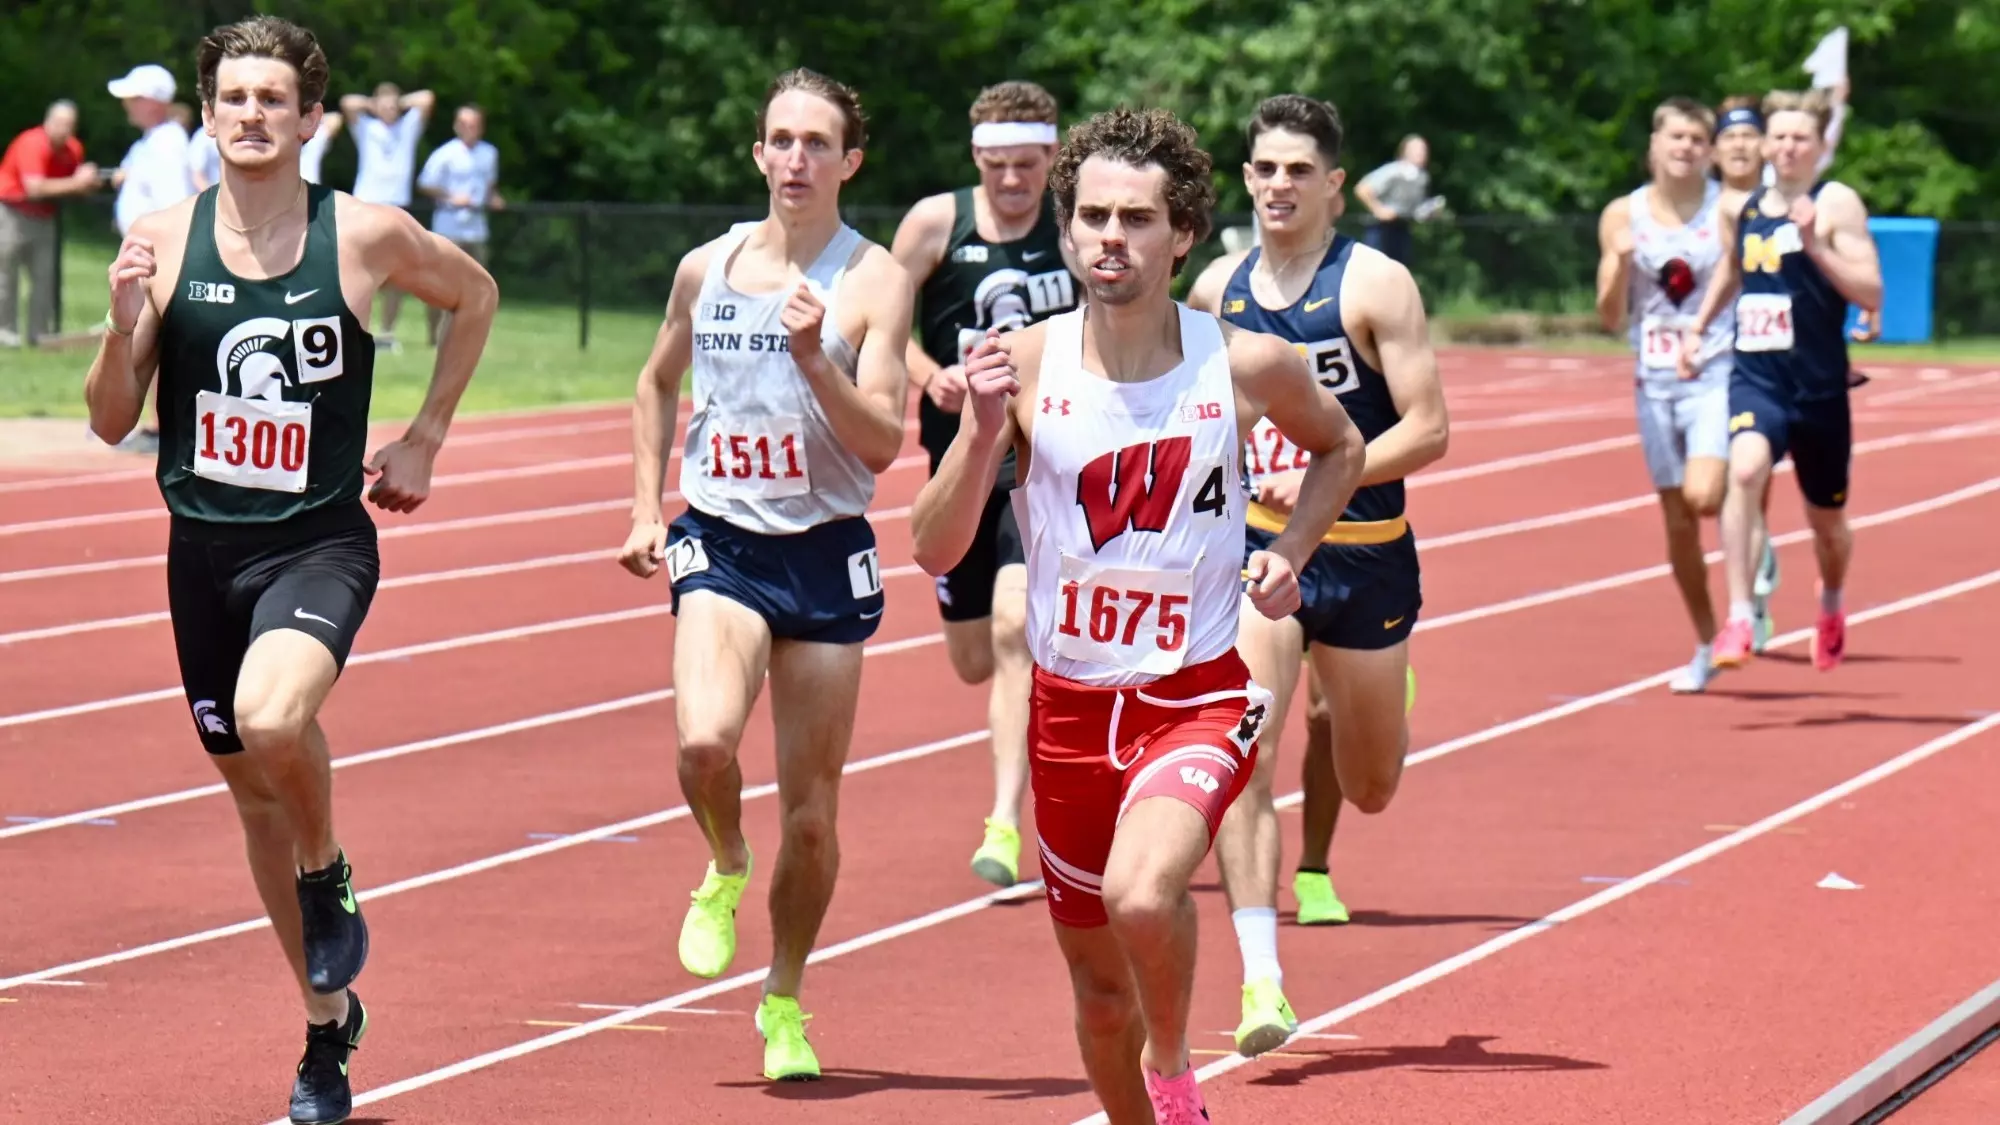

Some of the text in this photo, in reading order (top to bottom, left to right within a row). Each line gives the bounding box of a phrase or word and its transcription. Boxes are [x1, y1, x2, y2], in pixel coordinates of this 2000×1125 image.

[1037, 275, 1063, 308] 11
[302, 324, 338, 369] 9
[749, 333, 789, 352] STA
[1316, 348, 1349, 389] 5
[200, 411, 306, 472] 1300
[711, 432, 804, 480] 1511
[1076, 435, 1192, 555] W
[1192, 465, 1226, 518] 4
[666, 537, 699, 577] 12
[858, 552, 880, 592] 1
[1058, 579, 1189, 652] 1675
